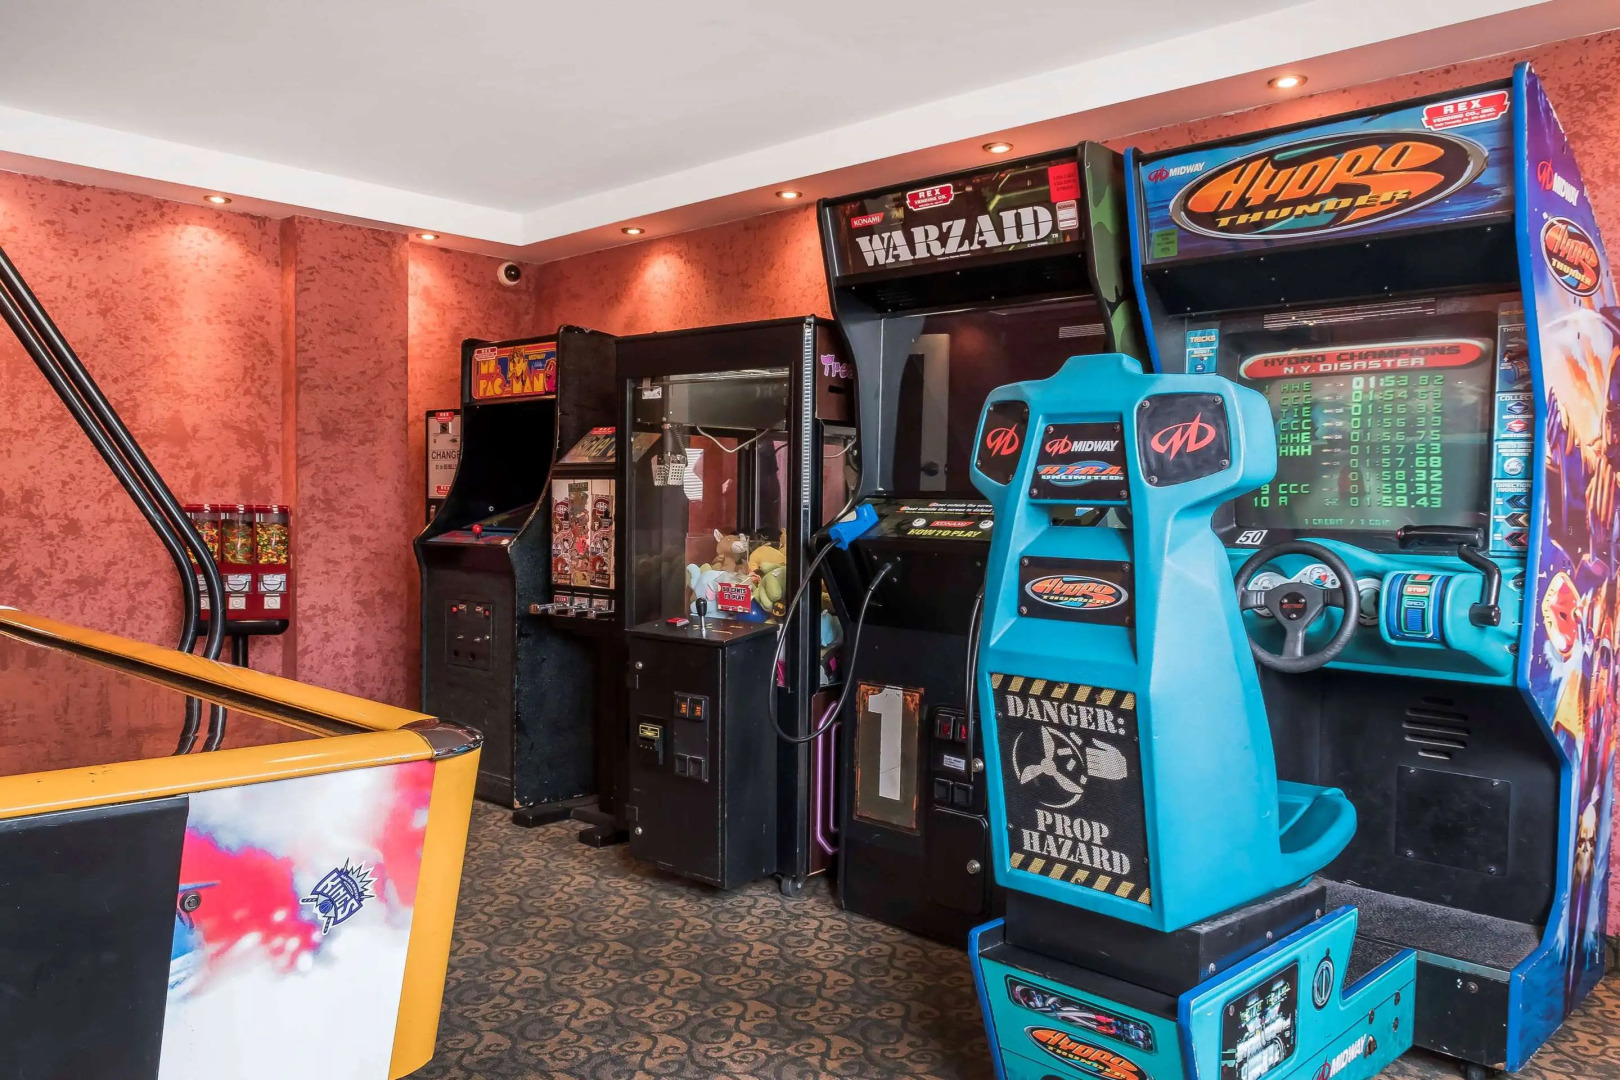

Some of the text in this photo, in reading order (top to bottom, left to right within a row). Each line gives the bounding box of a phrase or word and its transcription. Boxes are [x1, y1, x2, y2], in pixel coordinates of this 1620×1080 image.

[1443, 100, 1481, 114] REX
[1169, 162, 1205, 177] MIDWAY
[918, 188, 940, 199] REX
[1552, 172, 1579, 206] MIDWAY
[1216, 189, 1410, 227] THUNDER
[854, 215, 881, 226] KONAMI
[856, 206, 1052, 267] WARZAID
[1551, 258, 1592, 286] THUNDER
[1264, 345, 1461, 367] HYDRO CHAMPIONS
[1284, 357, 1426, 374] N.Y. DISASTER
[480, 373, 544, 397] PAC-MAN
[1281, 382, 1311, 393] HHE
[1281, 395, 1312, 406] CCC
[1281, 407, 1311, 418] TIE
[1280, 420, 1311, 431] CCC
[1280, 432, 1311, 443] HHE
[1071, 440, 1119, 452] MIDWAY
[1280, 445, 1312, 456] HHH
[431, 450, 460, 460] CHANGE
[1261, 484, 1269, 494] 9
[1279, 484, 1310, 494] CCC
[1254, 496, 1270, 507] 10
[1279, 496, 1288, 506] A
[907, 528, 935, 536] HOW
[1239, 531, 1264, 543] 50
[1006, 695, 1126, 735] DANGER:
[1036, 809, 1110, 846] PROP
[1022, 829, 1131, 875] HAZARD
[315, 872, 360, 921] KINGS
[1330, 1034, 1367, 1077] MIDWAY
